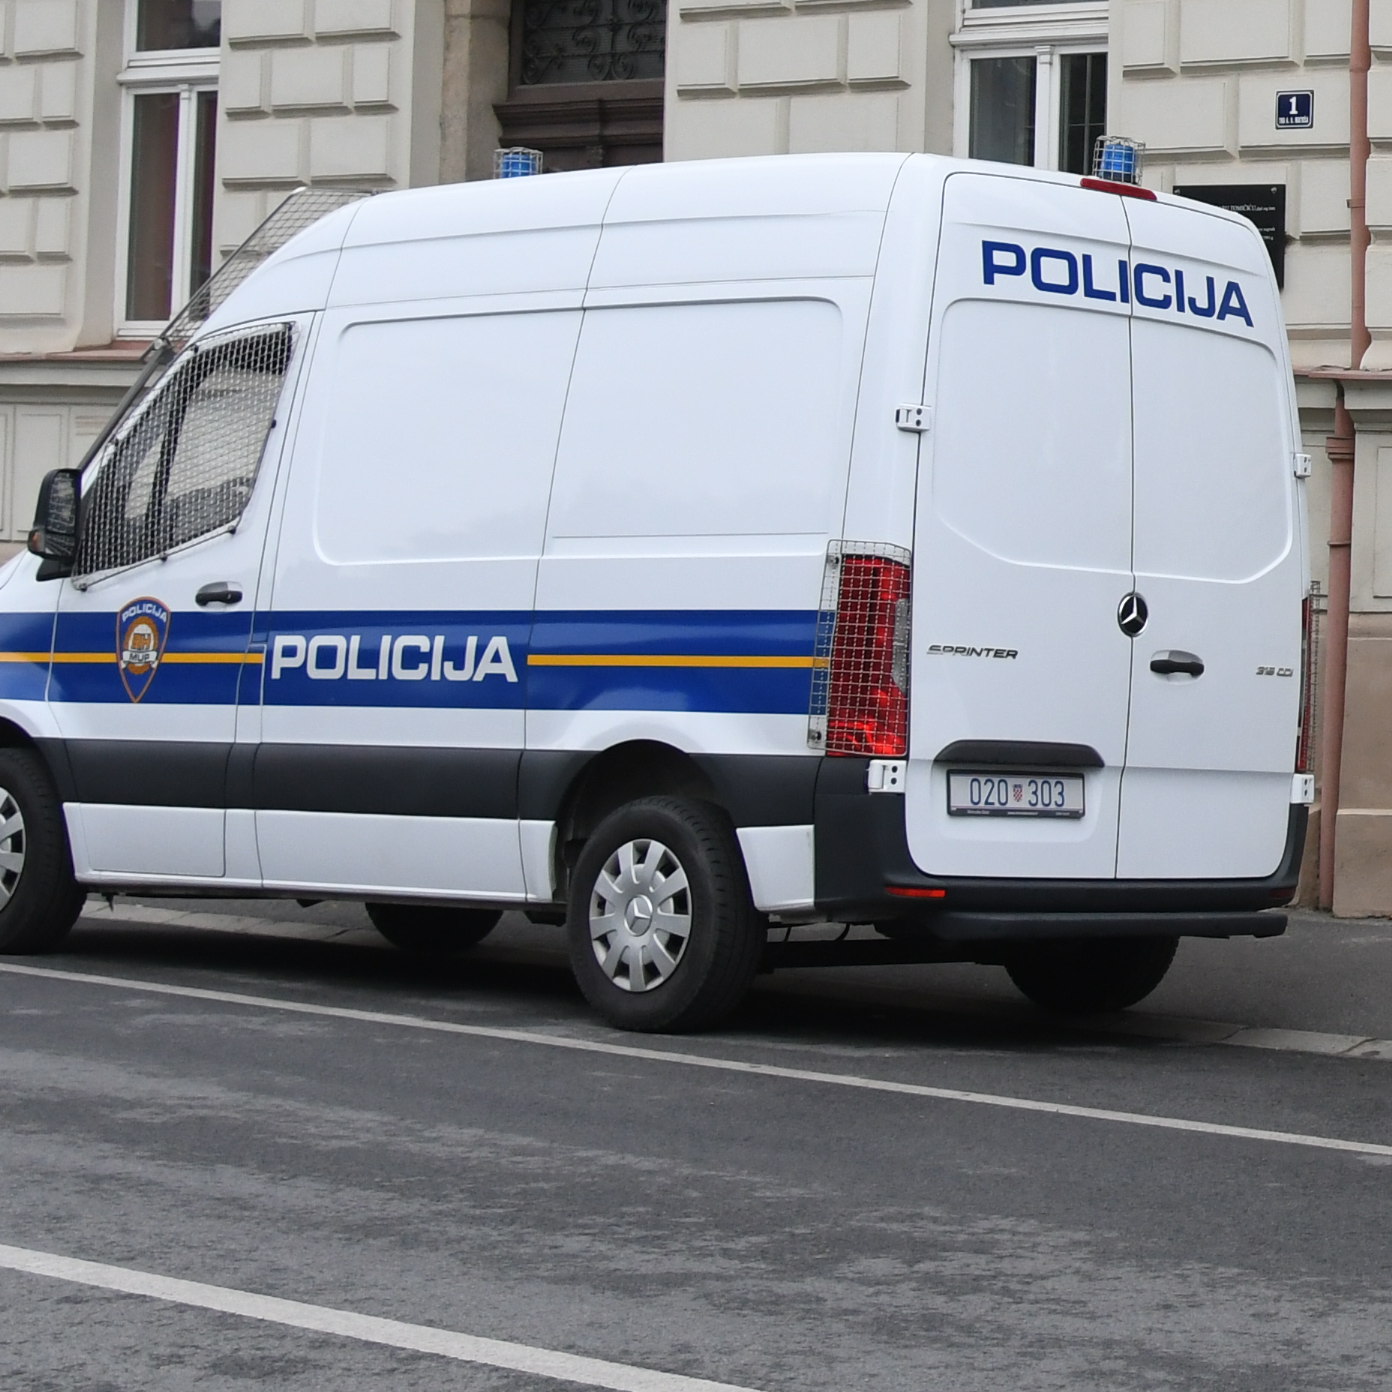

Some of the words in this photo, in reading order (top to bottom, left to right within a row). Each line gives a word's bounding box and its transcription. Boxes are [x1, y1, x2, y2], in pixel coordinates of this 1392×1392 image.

[1289, 96, 1298, 115] 1
[982, 240, 1254, 328] POLICIJA
[122, 603, 167, 623] POLICIJA
[129, 653, 150, 663] MUP
[271, 634, 519, 683] POLICIJA
[926, 644, 1018, 660] SPRINTER
[969, 778, 1008, 806] 020
[1028, 780, 1065, 807] 303
